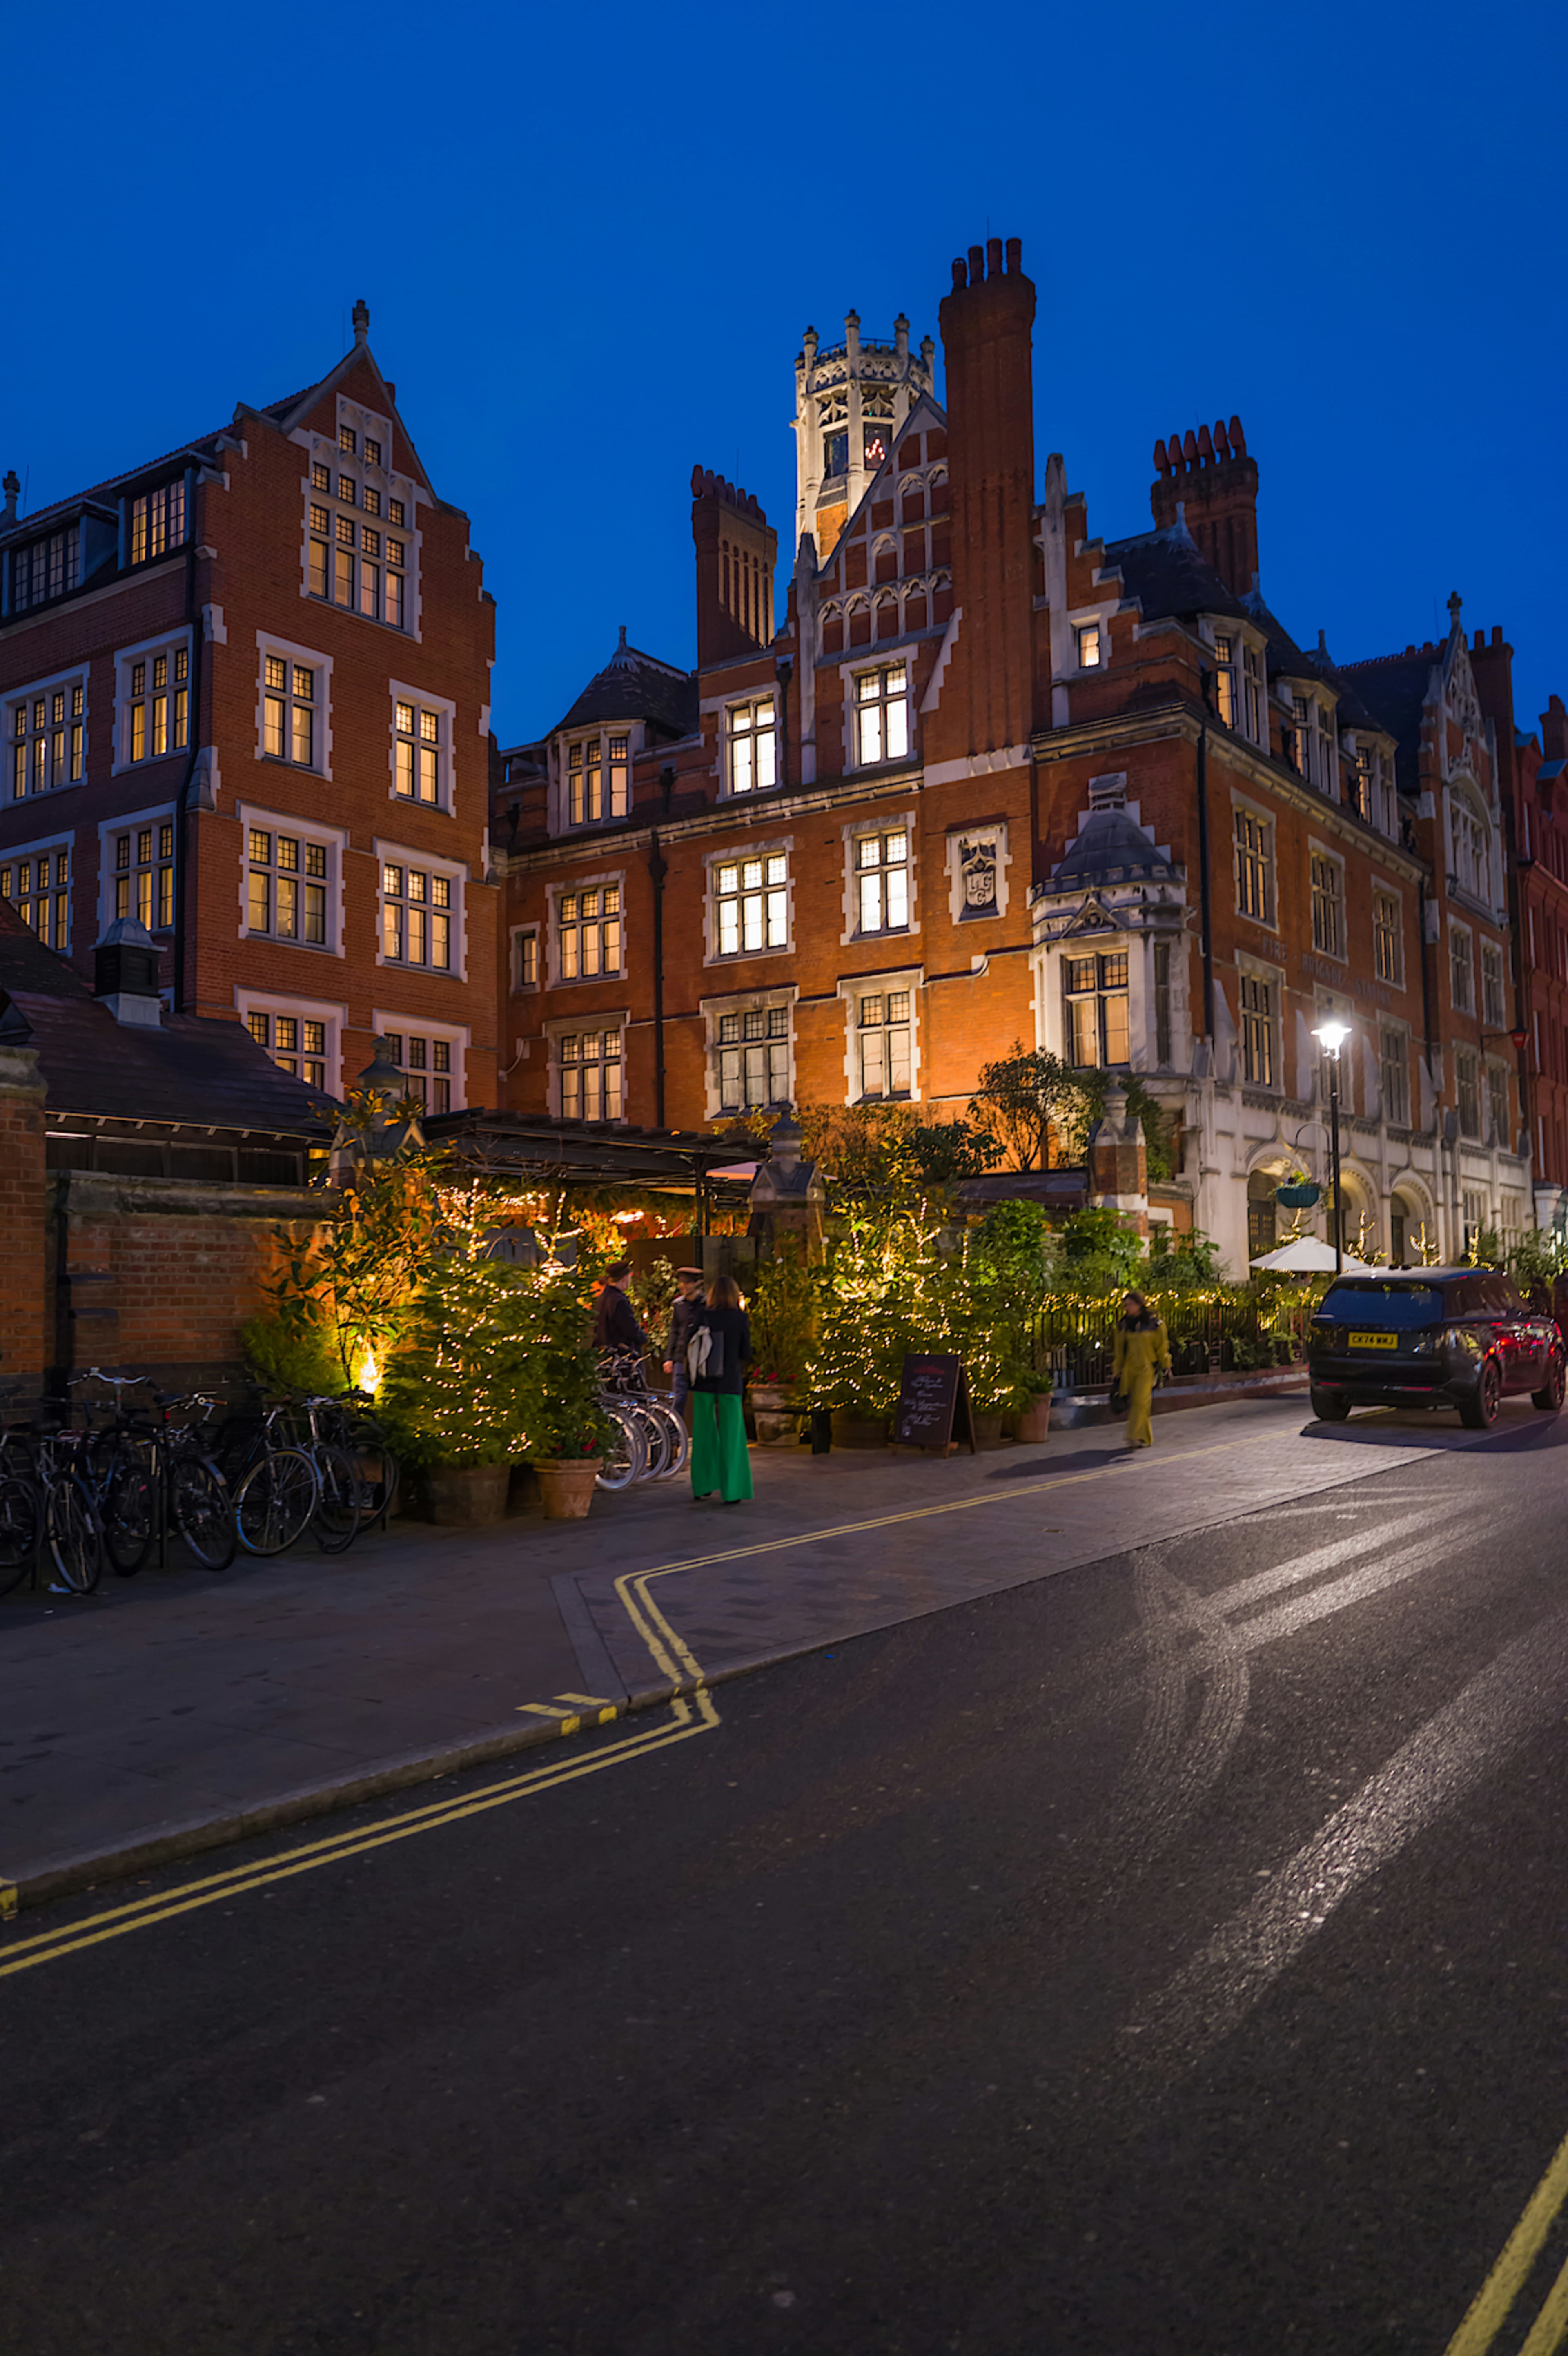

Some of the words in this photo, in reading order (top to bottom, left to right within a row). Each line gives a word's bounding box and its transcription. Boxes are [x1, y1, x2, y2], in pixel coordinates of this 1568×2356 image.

[1262, 934, 1287, 962] FIRE
[1301, 953, 1345, 986] BRIGADE
[1354, 978, 1391, 1006] STATION
